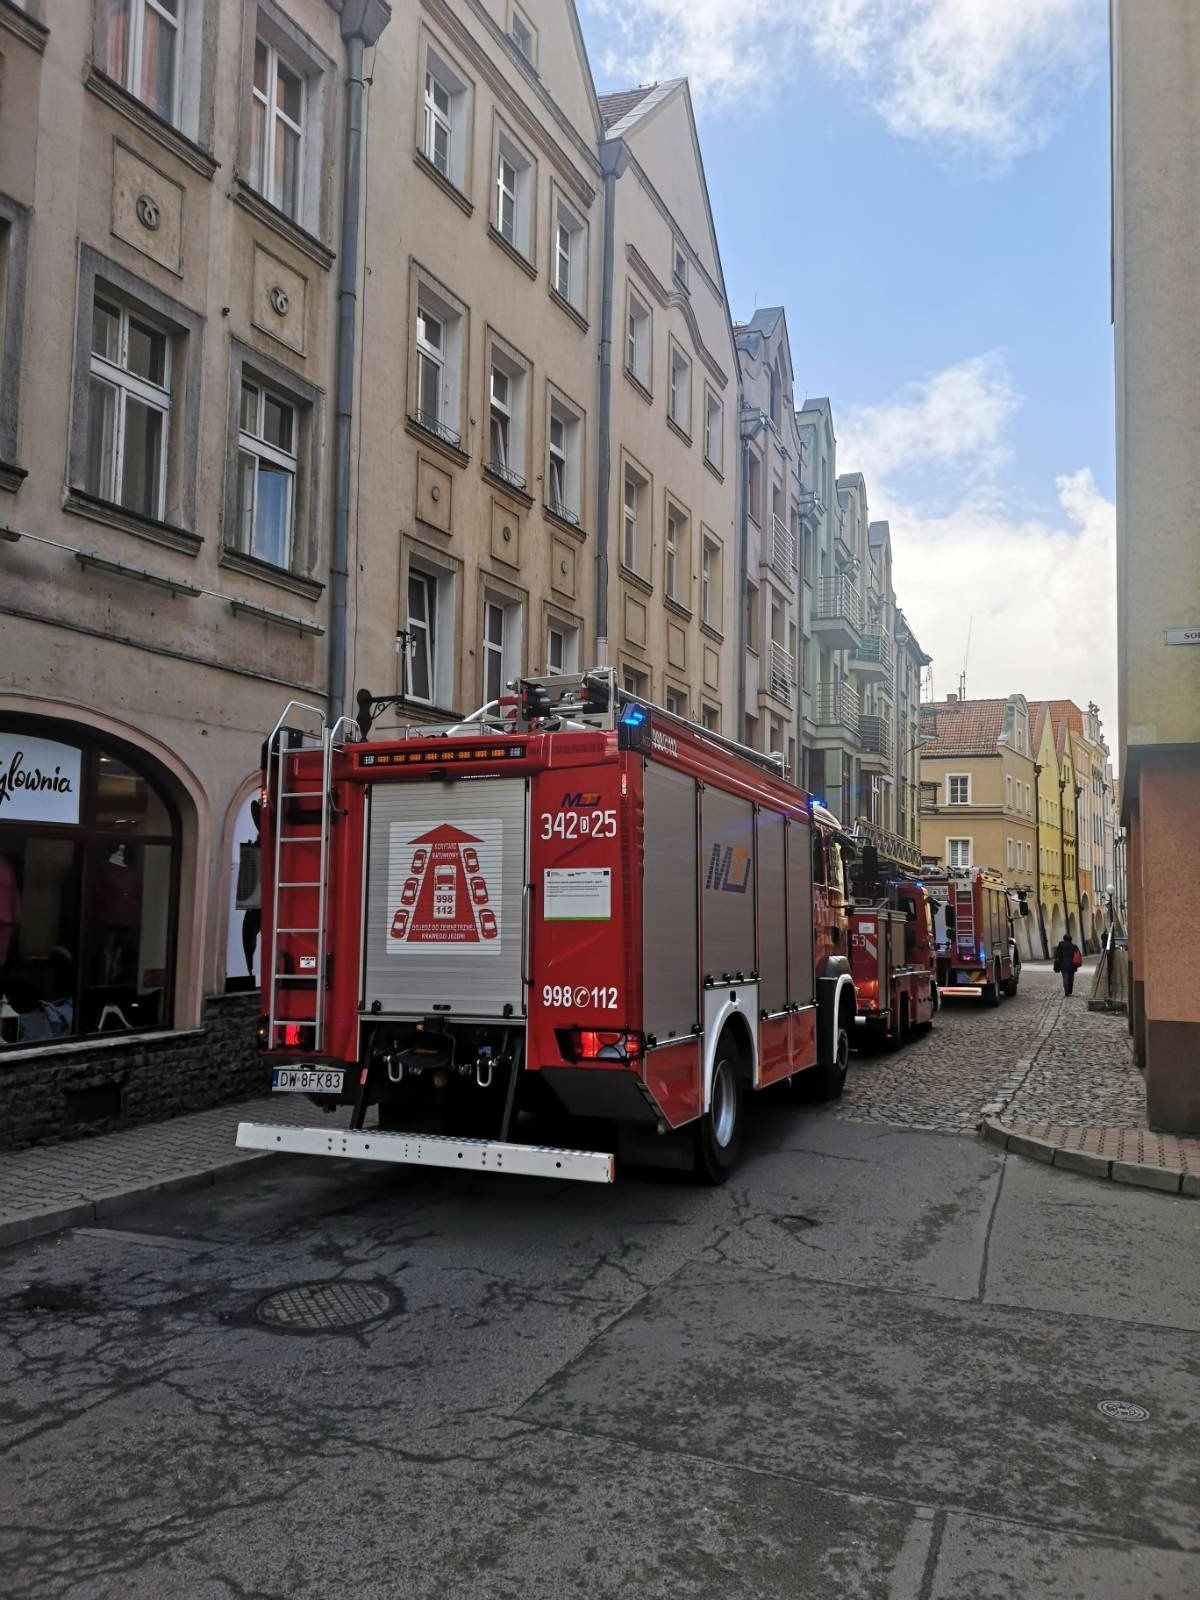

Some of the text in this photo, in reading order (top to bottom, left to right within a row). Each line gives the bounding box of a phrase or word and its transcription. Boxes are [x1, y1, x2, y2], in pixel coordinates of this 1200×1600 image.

[1184, 632, 1200, 640] SO
[540, 811, 578, 840] 342
[591, 809, 617, 838] 25
[436, 895, 453, 903] 998
[436, 906, 453, 915] 112
[852, 934, 866, 947] 53
[542, 985, 618, 1009] 998 112
[280, 1072, 341, 1088] DW 8FK83
